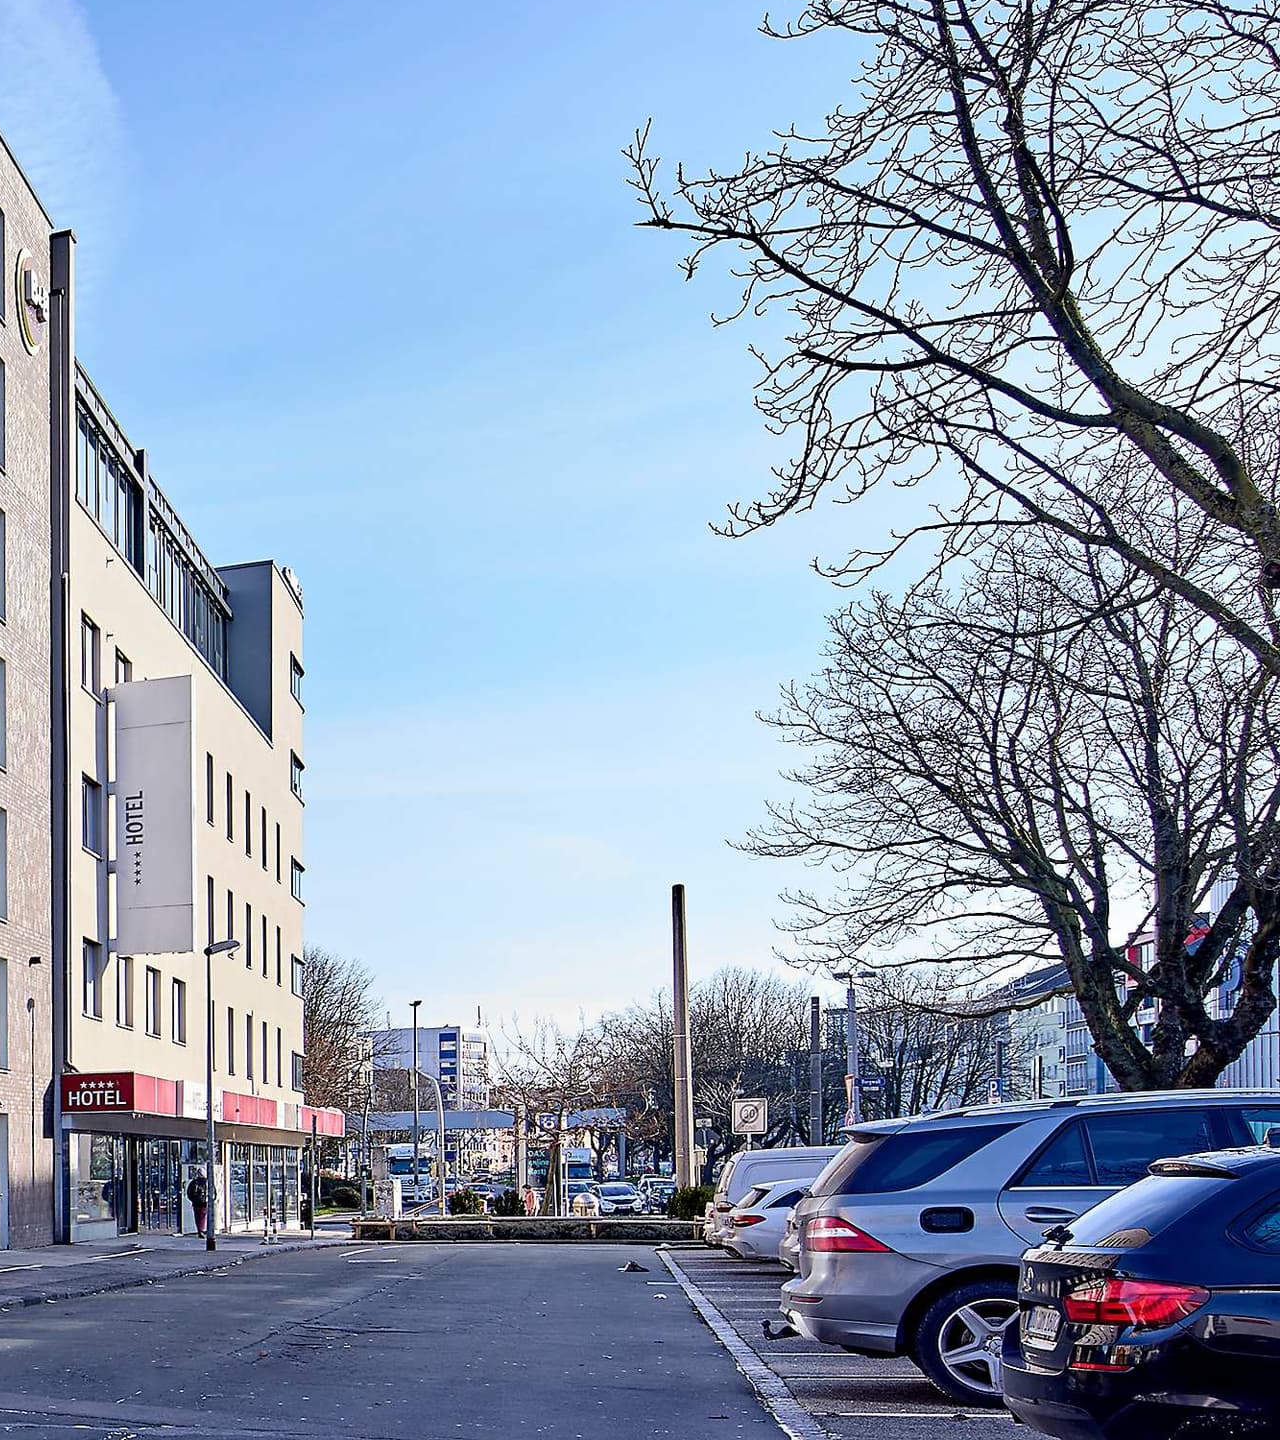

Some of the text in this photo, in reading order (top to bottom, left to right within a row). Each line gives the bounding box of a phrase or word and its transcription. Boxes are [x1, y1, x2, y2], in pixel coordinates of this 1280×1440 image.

[125, 790, 144, 846] HOTEL
[990, 1081, 998, 1097] P
[68, 1090, 127, 1107] HOTEL
[743, 1109, 756, 1120] 30
